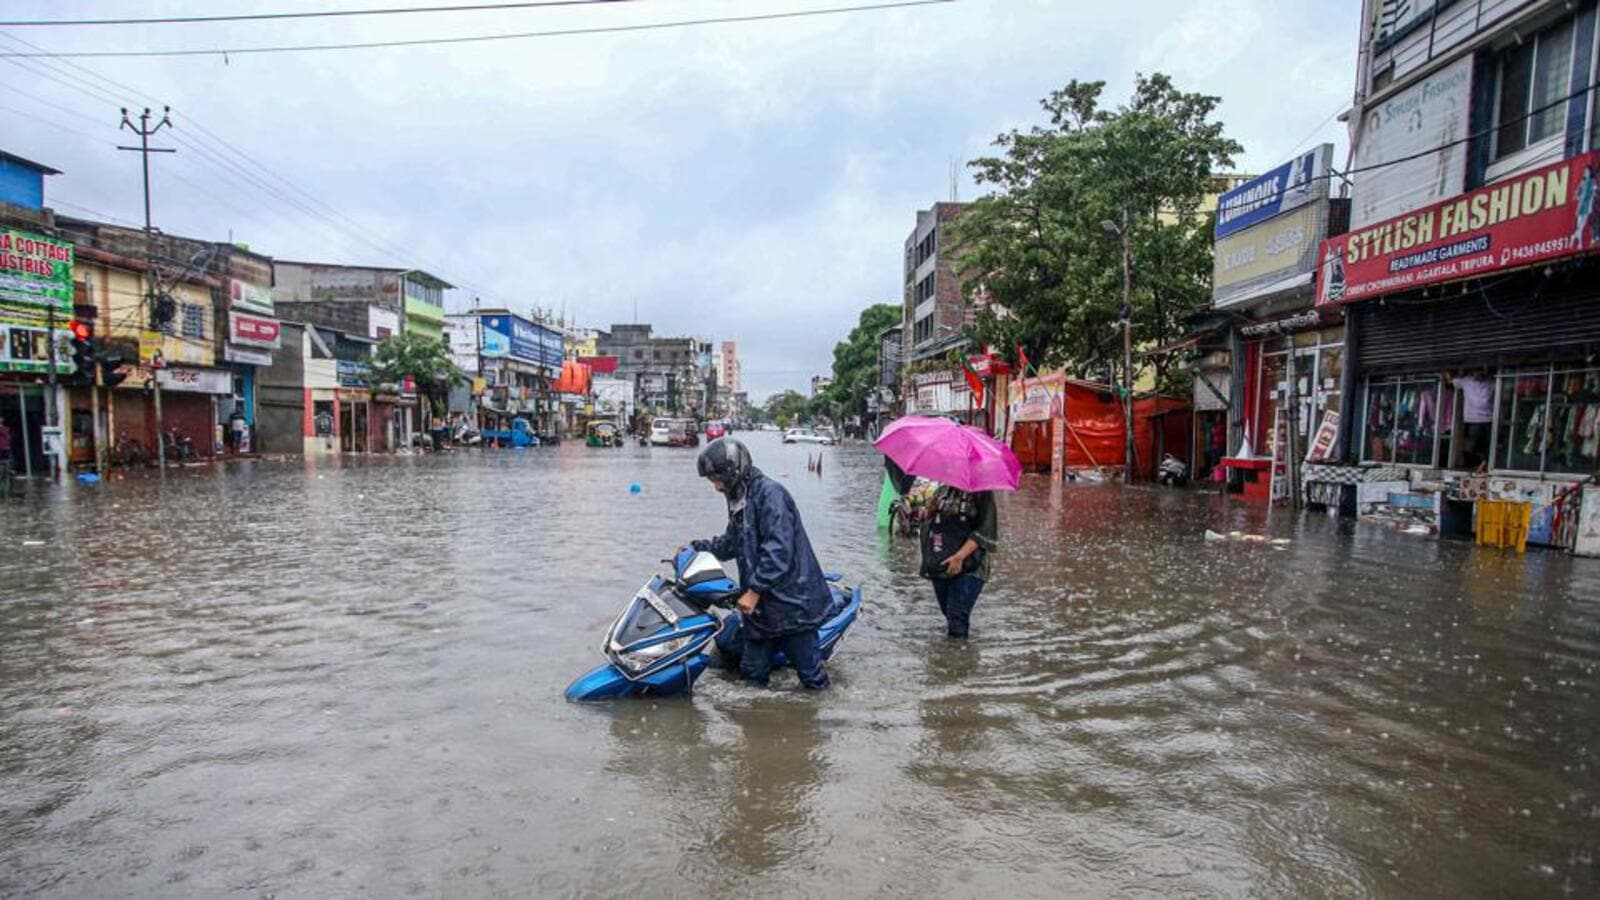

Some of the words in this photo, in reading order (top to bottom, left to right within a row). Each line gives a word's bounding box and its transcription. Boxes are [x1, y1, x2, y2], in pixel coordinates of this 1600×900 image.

[1218, 175, 1281, 225] LUMINOUS
[1347, 209, 1436, 265] STYLISH
[1439, 166, 1570, 239] FASHION
[16, 237, 71, 262] COTTAGE
[1390, 249, 1440, 271] READYMADE
[1439, 236, 1488, 261] GARMENTS
[1460, 255, 1494, 270] TRIPURA
